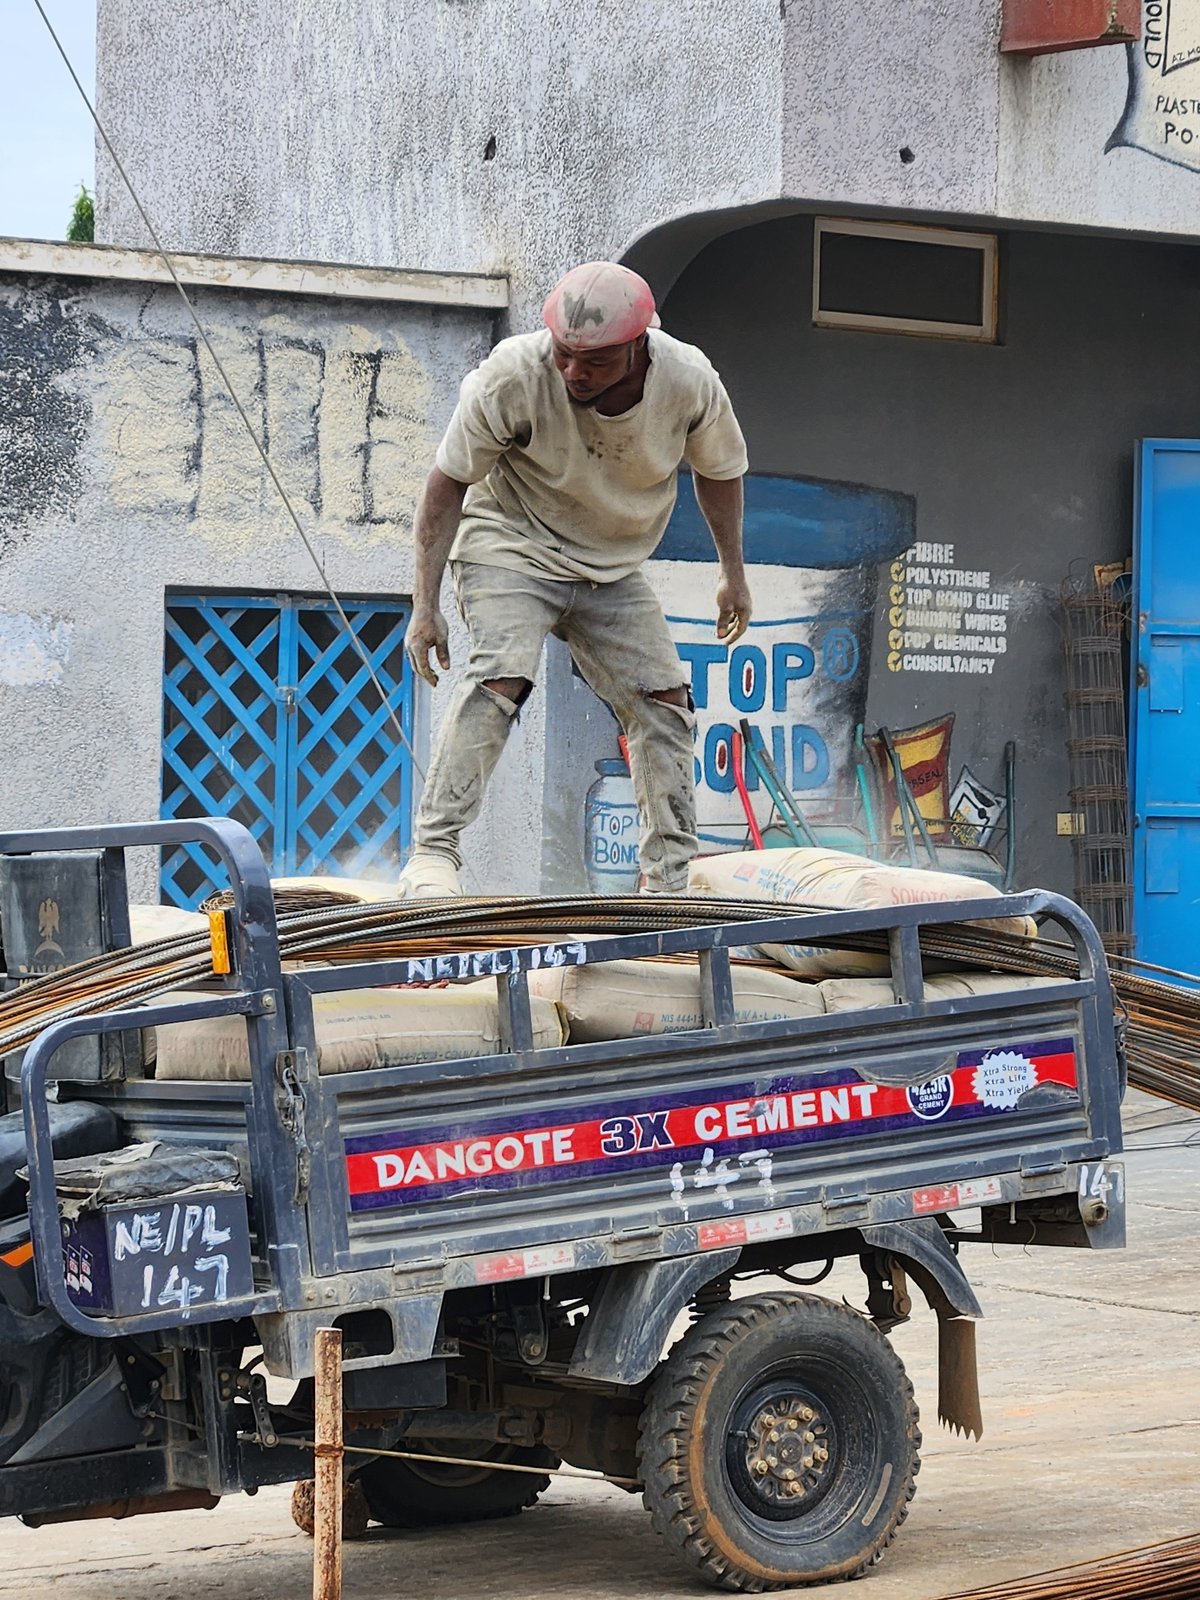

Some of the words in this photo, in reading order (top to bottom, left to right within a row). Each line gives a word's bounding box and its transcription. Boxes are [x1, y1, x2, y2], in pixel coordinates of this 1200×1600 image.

[906, 567, 990, 588] POLYSTRENE
[906, 588, 932, 605] TOP
[935, 590, 972, 608] BOND
[976, 593, 1010, 610] GLUE
[965, 613, 1007, 632] WIRES
[904, 631, 931, 648] POP
[934, 633, 1007, 653] CHEMICALS
[903, 654, 995, 674] CONSULTANCY
[694, 722, 830, 793] OND
[596, 813, 634, 836] TOP
[983, 1068, 1000, 1077] Xtra
[1002, 1064, 1027, 1074] Strong
[1009, 1074, 1027, 1083] Life
[919, 1093, 943, 1102] GRAND
[985, 1088, 1004, 1097] Xtra
[1007, 1085, 1030, 1095] Yield
[918, 1099, 945, 1109] CEMENT
[372, 1128, 575, 1188] DANGOTE
[600, 1111, 675, 1156] 3X
[694, 1084, 878, 1141] CEMENT
[115, 1203, 231, 1261] NE/PL
[141, 1254, 230, 1309] 147
